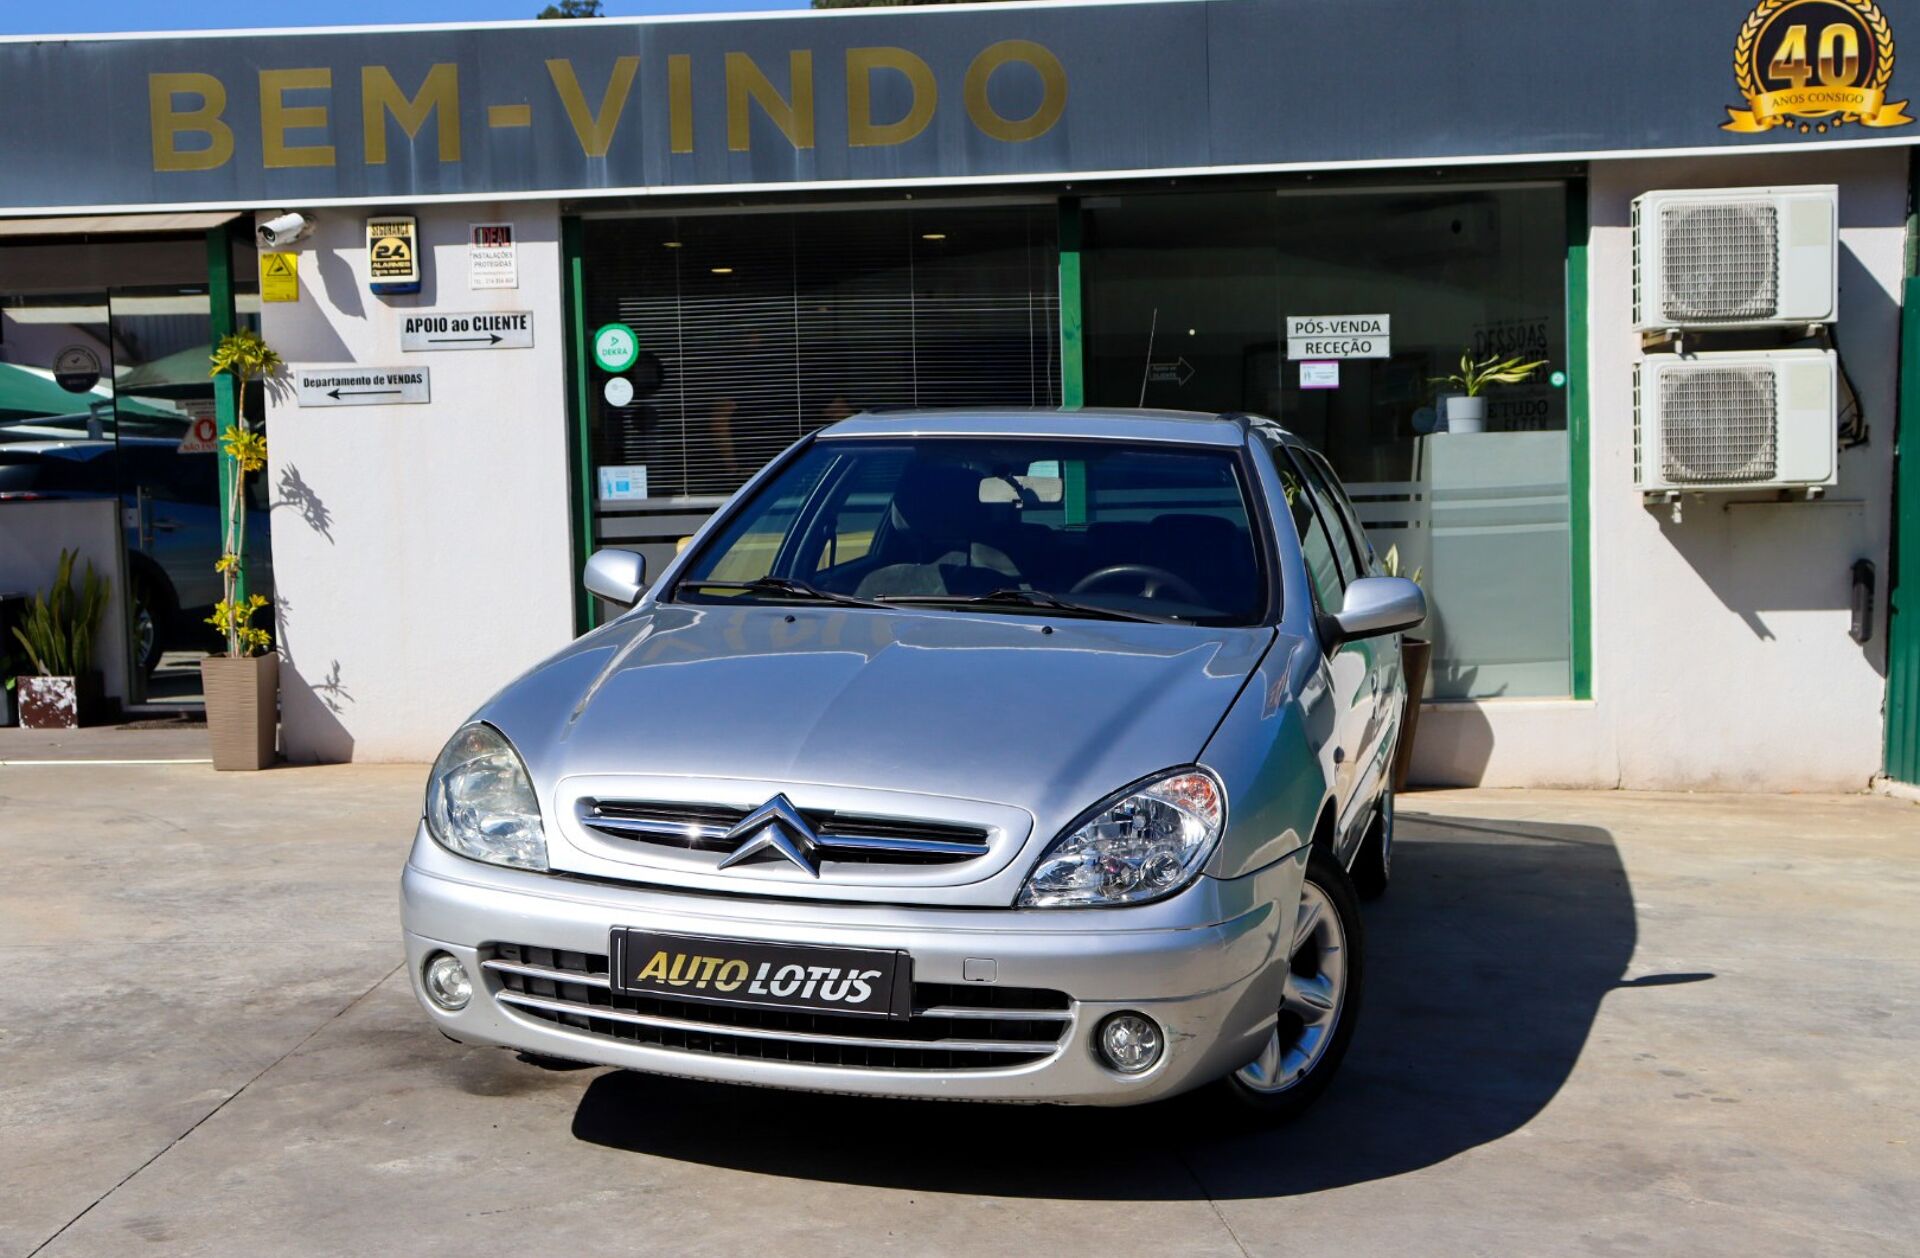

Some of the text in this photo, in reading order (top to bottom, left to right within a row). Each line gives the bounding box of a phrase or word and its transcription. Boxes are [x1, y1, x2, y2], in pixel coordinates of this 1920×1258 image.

[1768, 22, 1859, 88] 40
[148, 39, 1068, 172] BEM-VINDO
[1772, 92, 1864, 108] ANOS CONSIGO
[375, 245, 405, 258] 24
[474, 260, 512, 268] PROTEGIDAS
[405, 315, 527, 333] APOIO ao CLIENTE
[1295, 318, 1381, 334] PÓS-VENDA
[602, 348, 628, 356] DEKRA
[1305, 338, 1372, 356] RECEÇÃO
[303, 373, 423, 388] Departamento de VENDAS
[637, 951, 882, 1003] AUTO LOTUS
